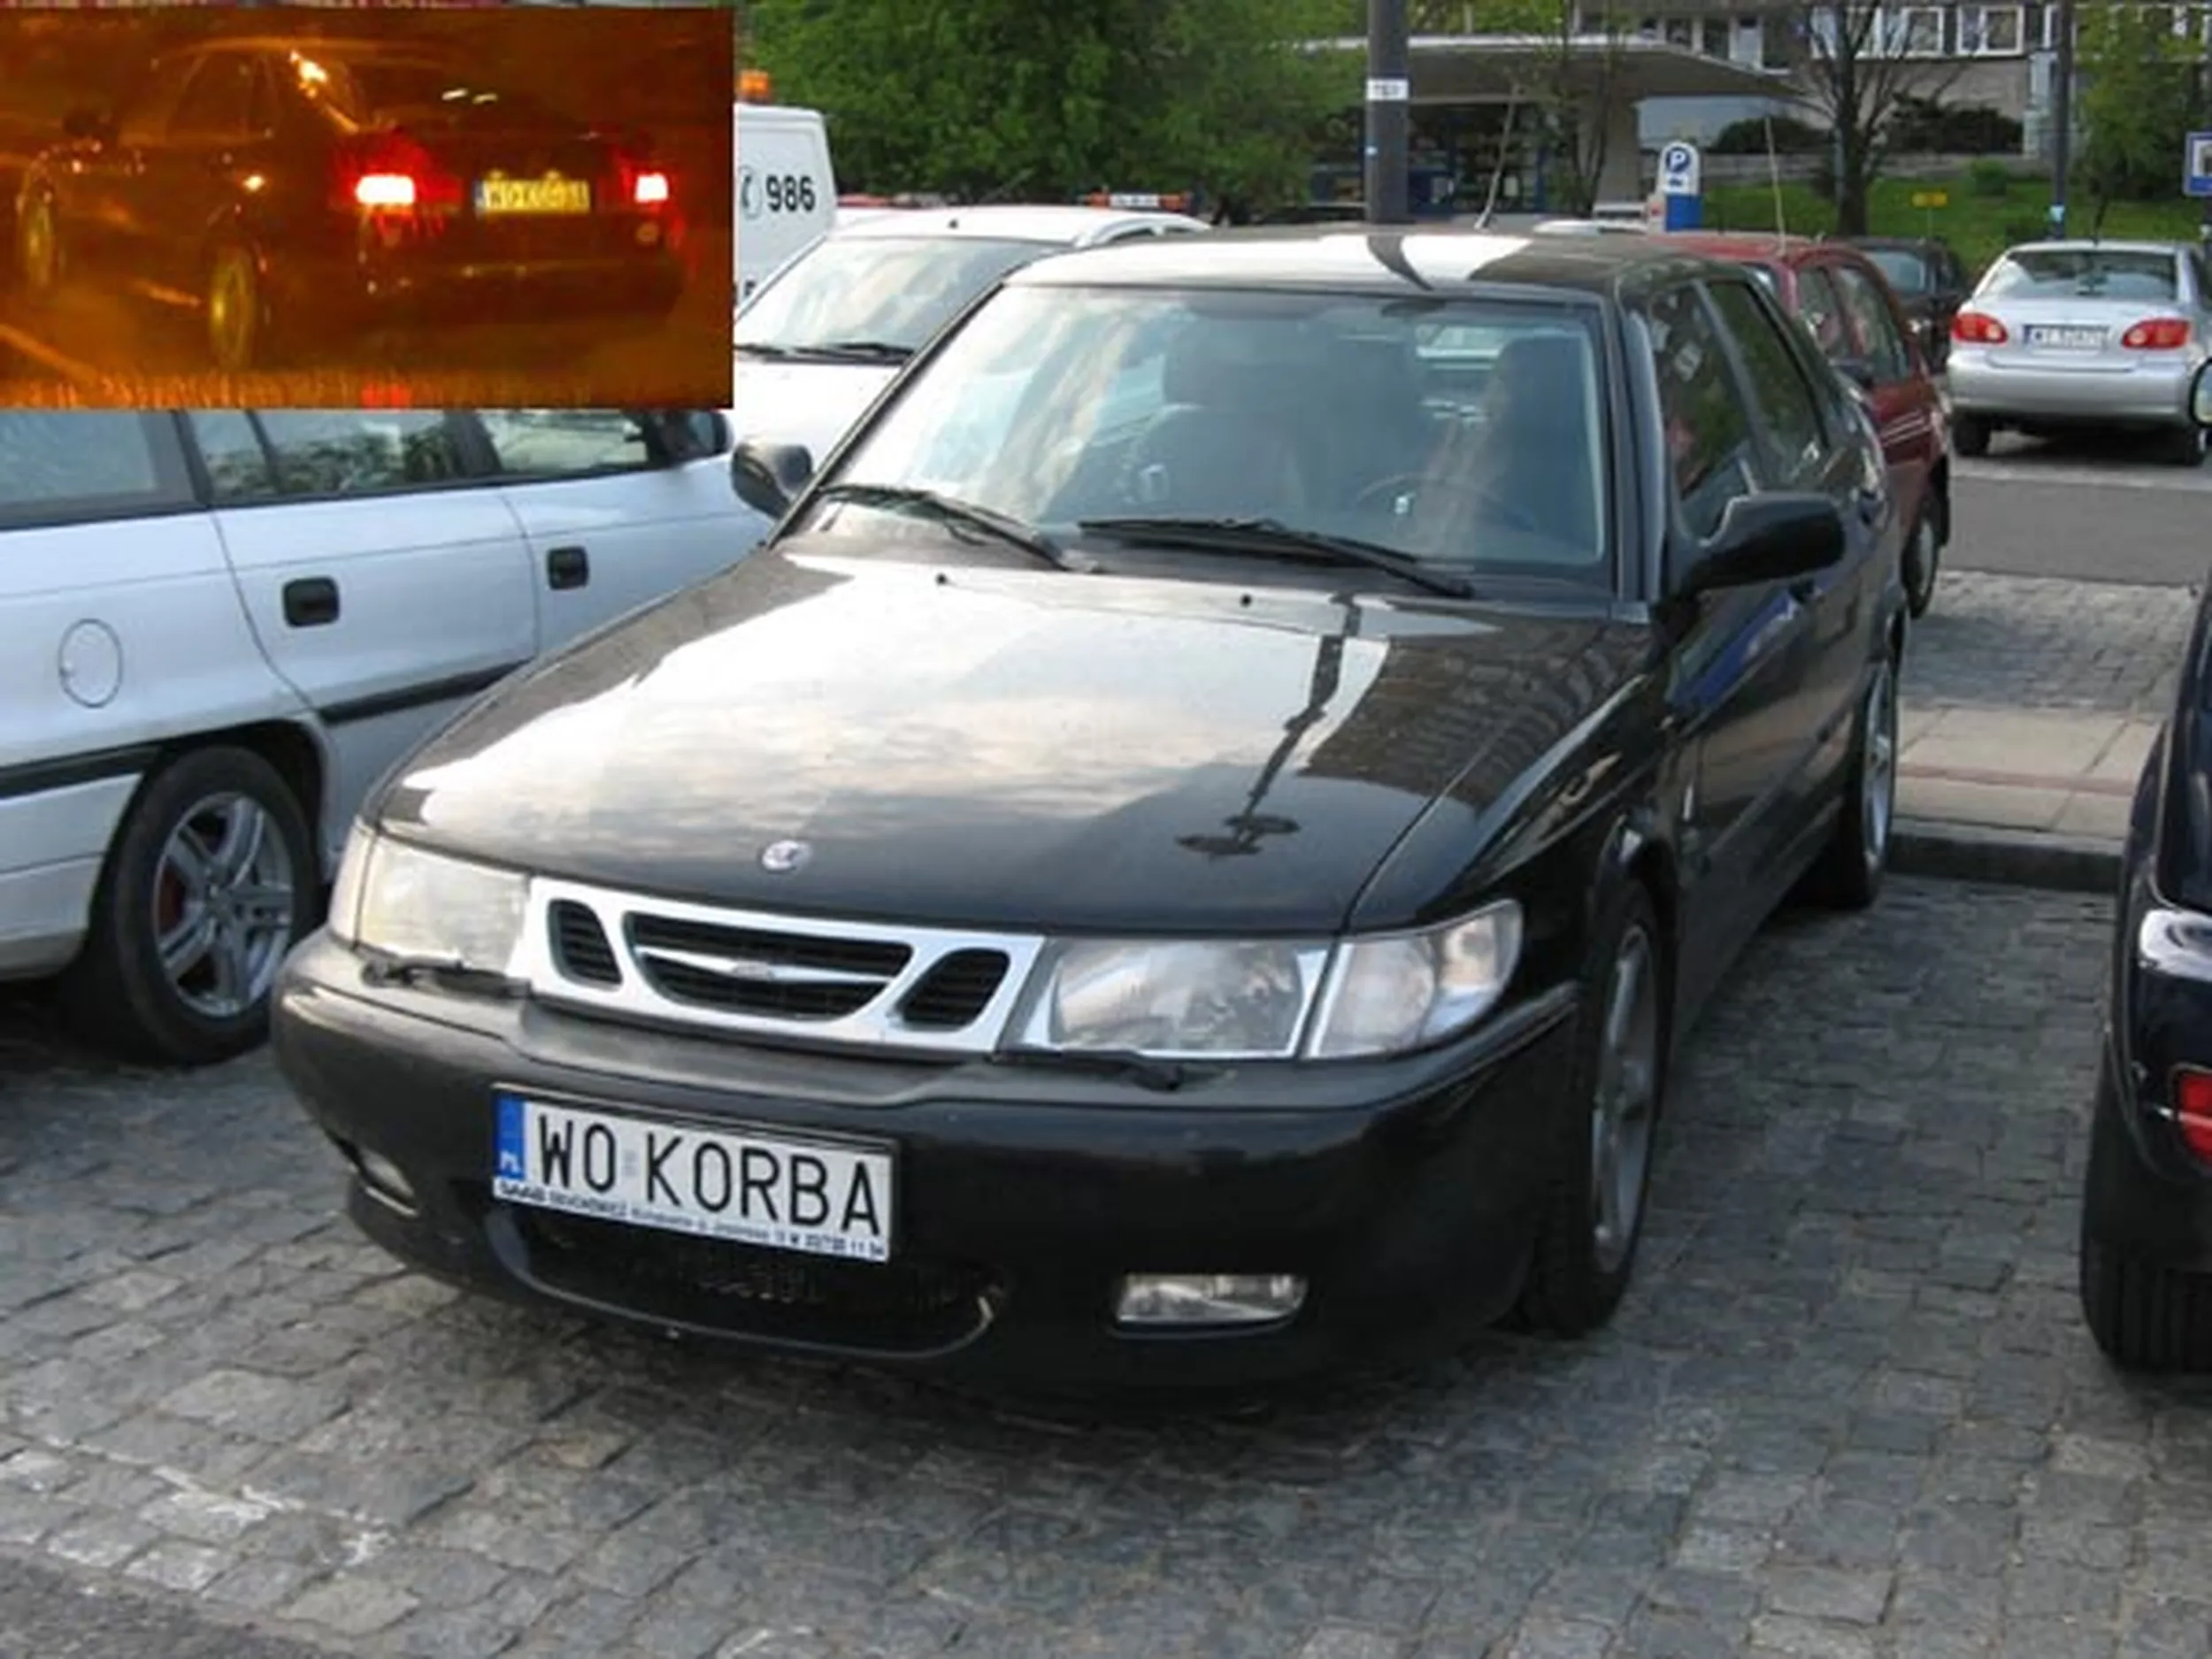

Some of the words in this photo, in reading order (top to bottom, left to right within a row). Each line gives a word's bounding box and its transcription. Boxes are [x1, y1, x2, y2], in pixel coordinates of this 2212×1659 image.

[765, 174, 817, 212] 986
[538, 1113, 616, 1194] WO
[646, 1132, 881, 1237] KORBA
